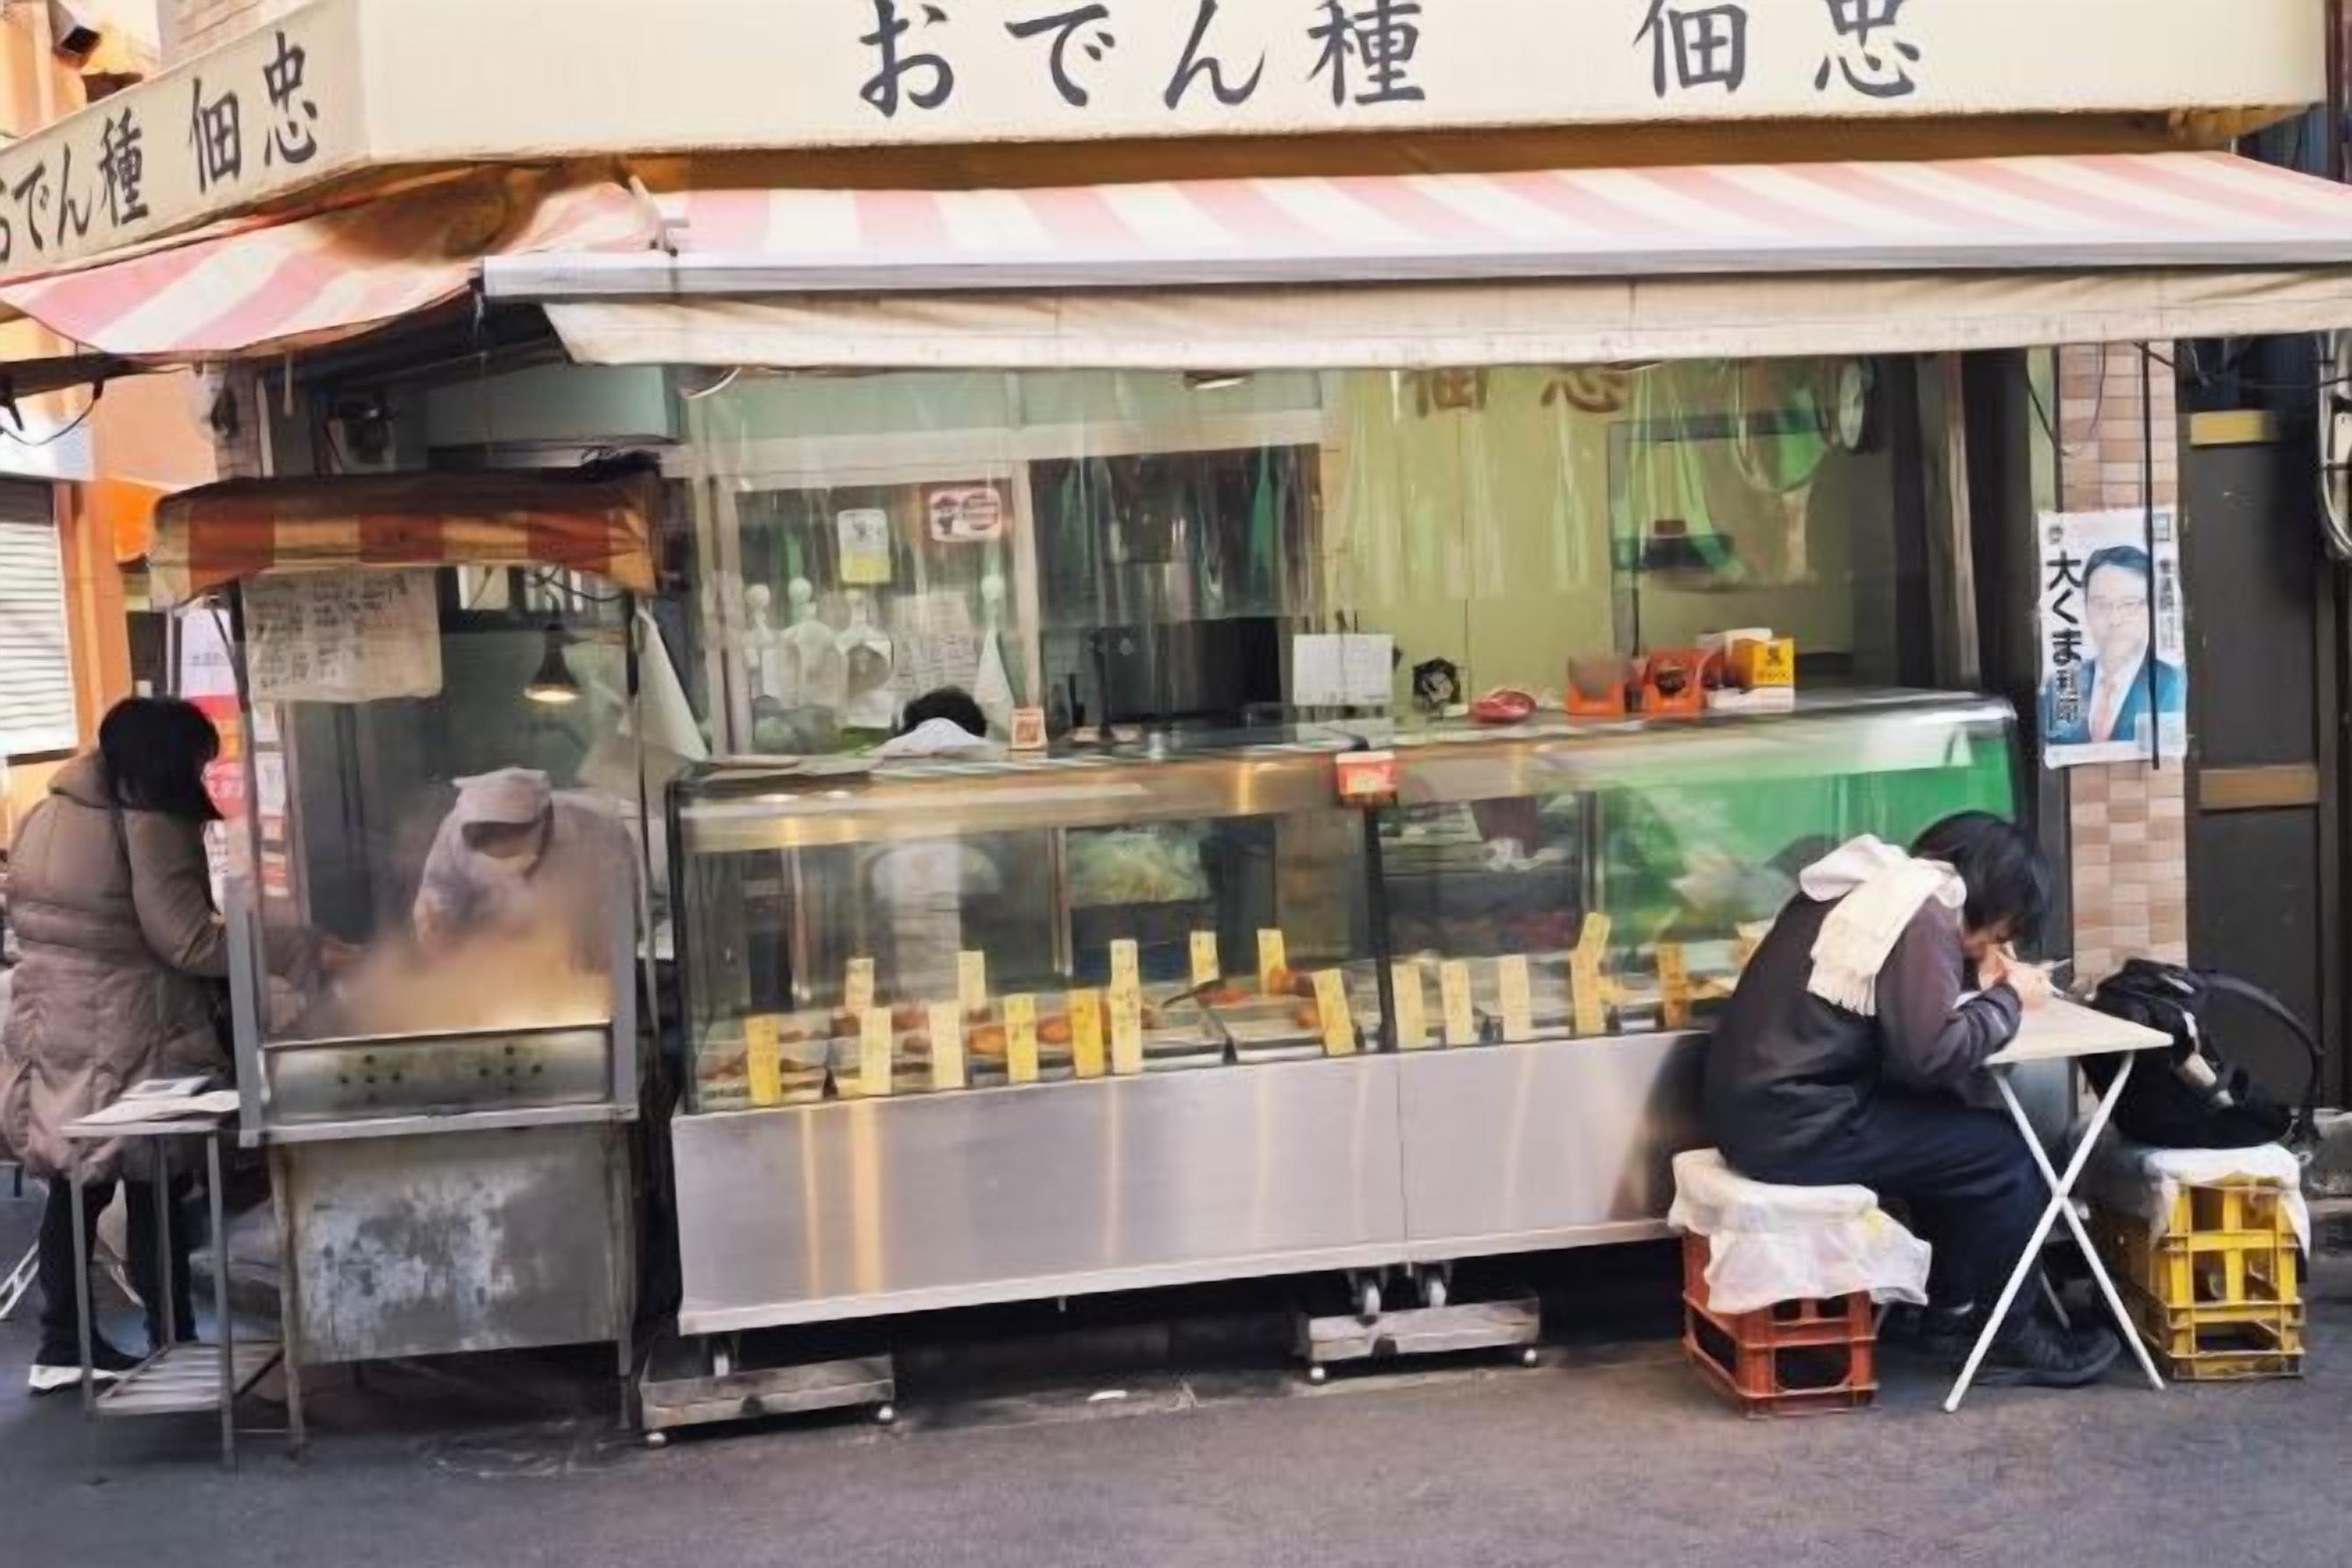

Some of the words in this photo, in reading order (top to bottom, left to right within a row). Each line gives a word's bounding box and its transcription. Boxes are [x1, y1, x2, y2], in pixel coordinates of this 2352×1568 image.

[190, 31, 317, 193] 佃忠
[861, 0, 1425, 117] おでん種
[1636, 0, 1920, 97] 佃忠
